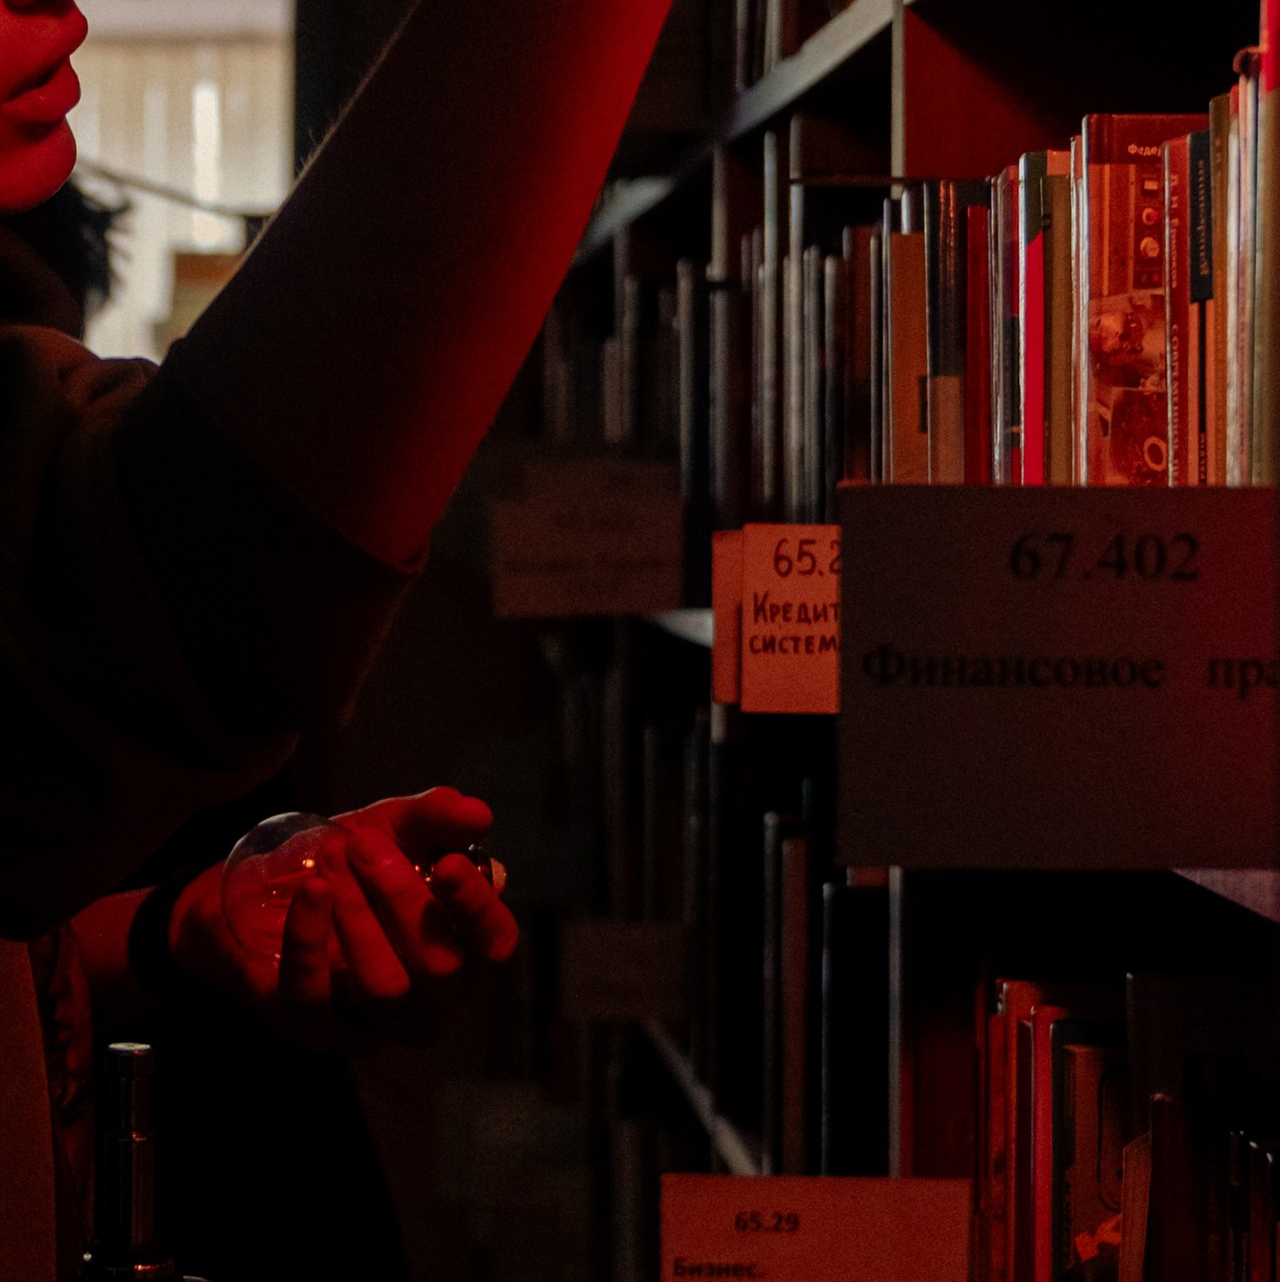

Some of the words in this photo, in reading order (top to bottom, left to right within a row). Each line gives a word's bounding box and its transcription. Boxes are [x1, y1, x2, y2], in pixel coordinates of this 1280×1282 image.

[1010, 532, 1202, 582] 67.402
[861, 644, 1165, 689] Финансовое
[734, 1211, 800, 1233] 65.29
[673, 1257, 769, 1279] Бизнес.
